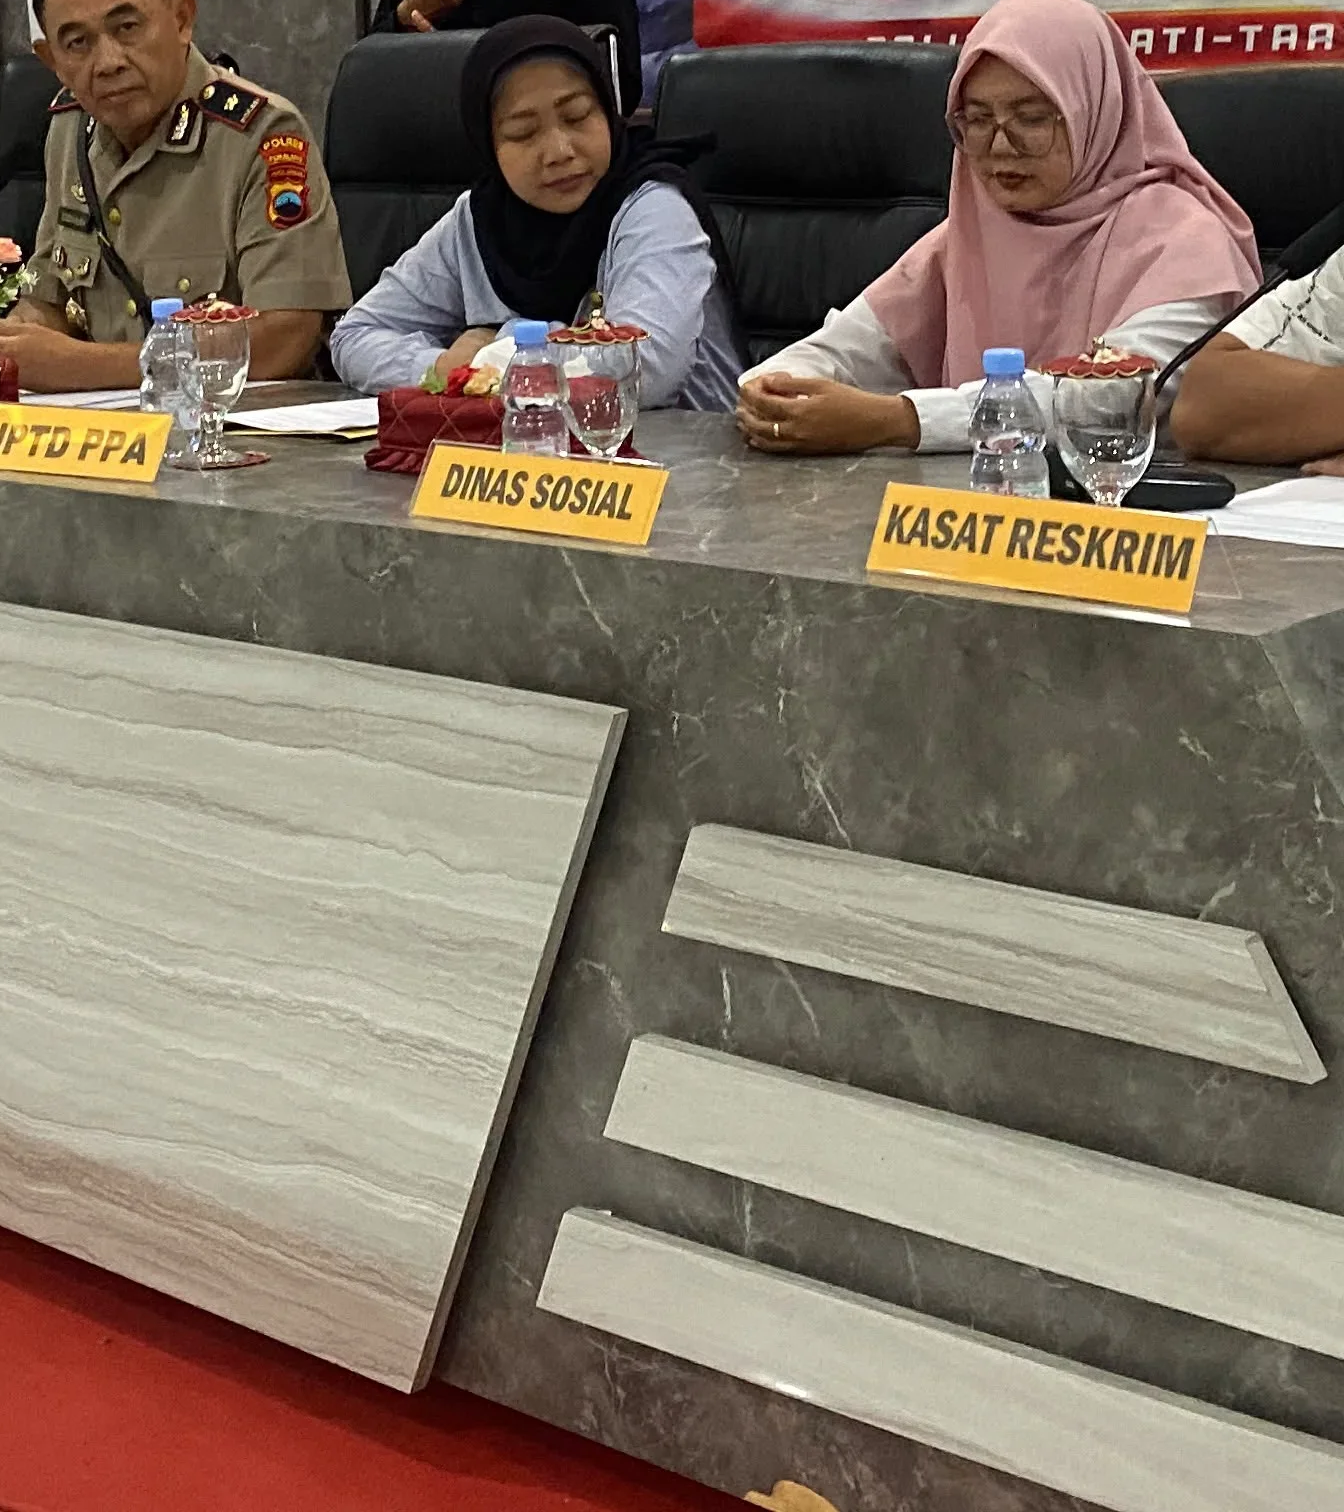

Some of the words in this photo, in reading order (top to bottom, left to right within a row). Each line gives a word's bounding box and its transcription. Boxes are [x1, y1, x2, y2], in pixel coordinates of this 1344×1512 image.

[78, 428, 147, 466] PPA
[441, 464, 529, 506] DINAS
[530, 474, 633, 521] SOSIAL
[883, 504, 1004, 555] KASAT
[1006, 517, 1196, 581] RESKRIM
